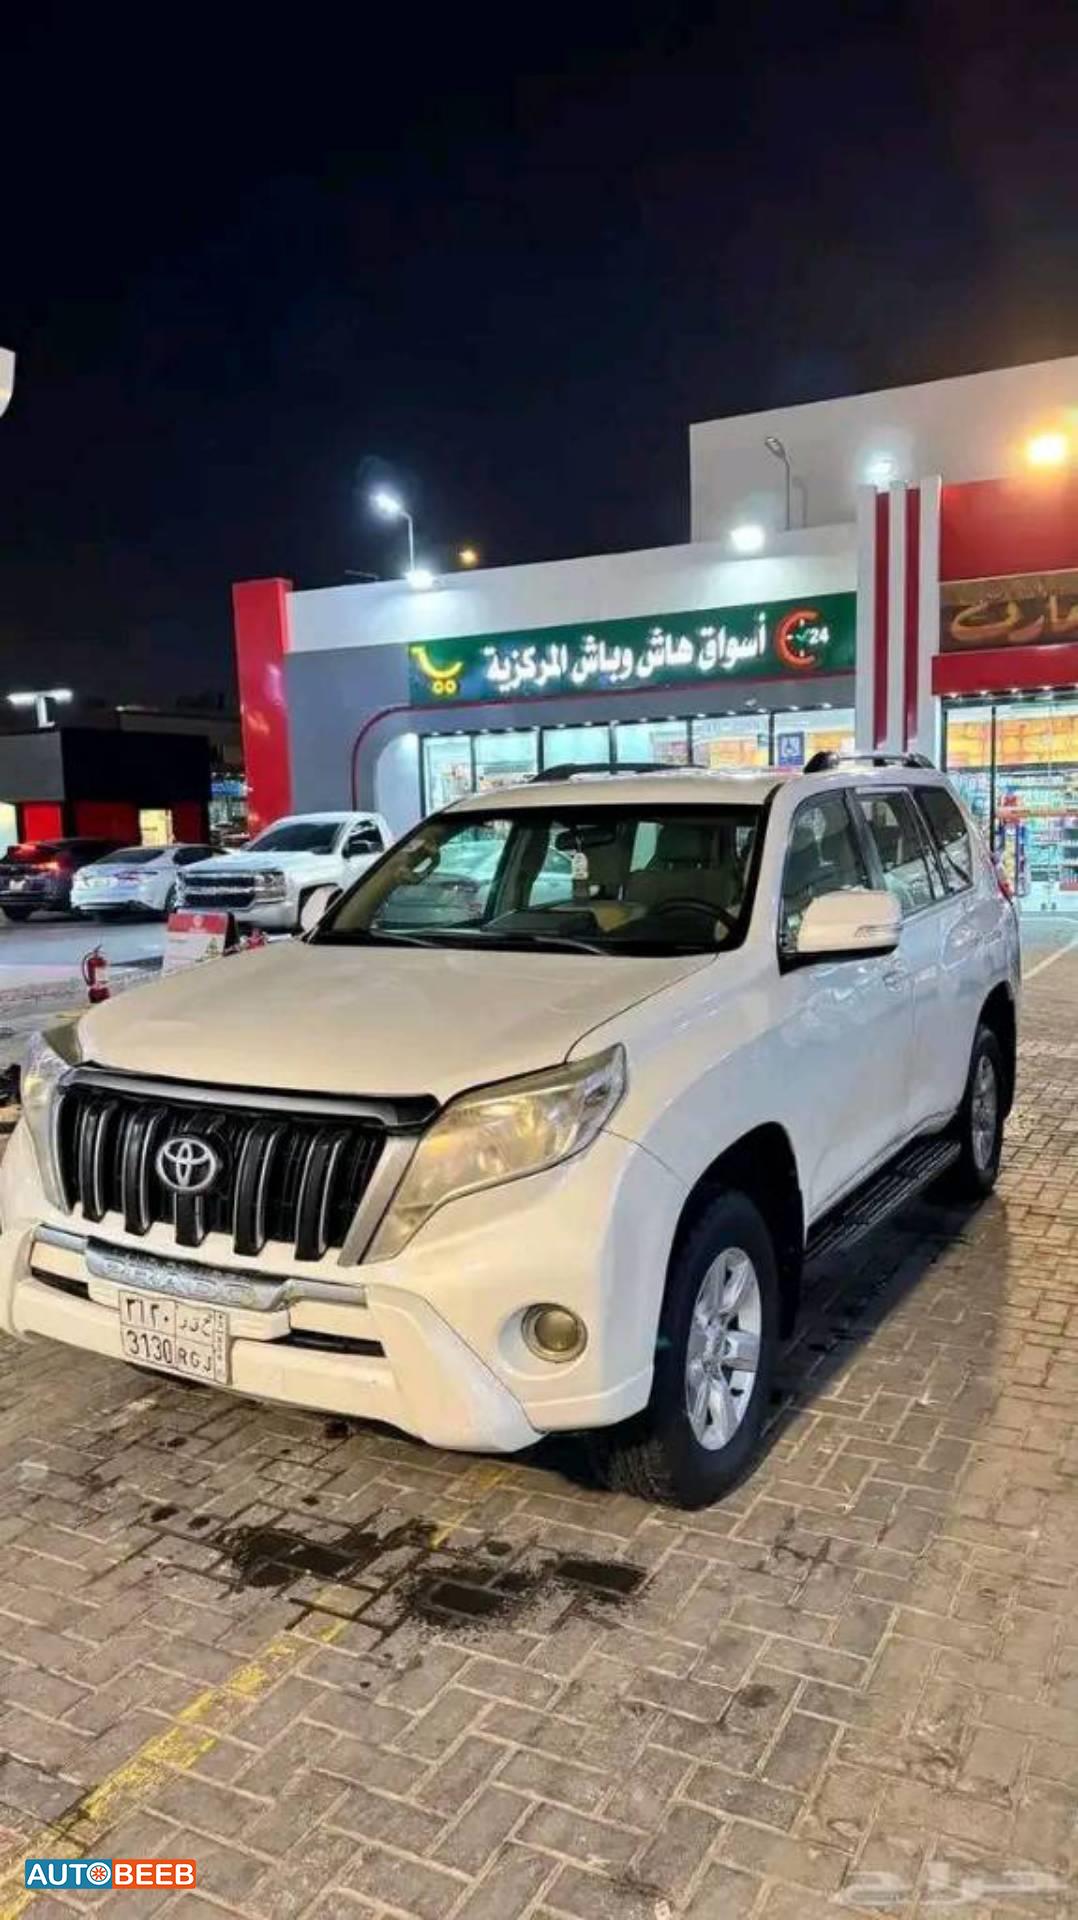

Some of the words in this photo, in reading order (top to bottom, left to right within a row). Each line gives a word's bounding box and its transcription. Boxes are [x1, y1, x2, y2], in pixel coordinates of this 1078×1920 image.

[571, 634, 635, 684] وباش
[636, 626, 695, 679] هاش
[698, 611, 768, 670] أسواق
[808, 626, 831, 646] 24
[481, 642, 569, 693] المركزية
[126, 1329, 173, 1364] 3130
[178, 1346, 212, 1372] RGJ
